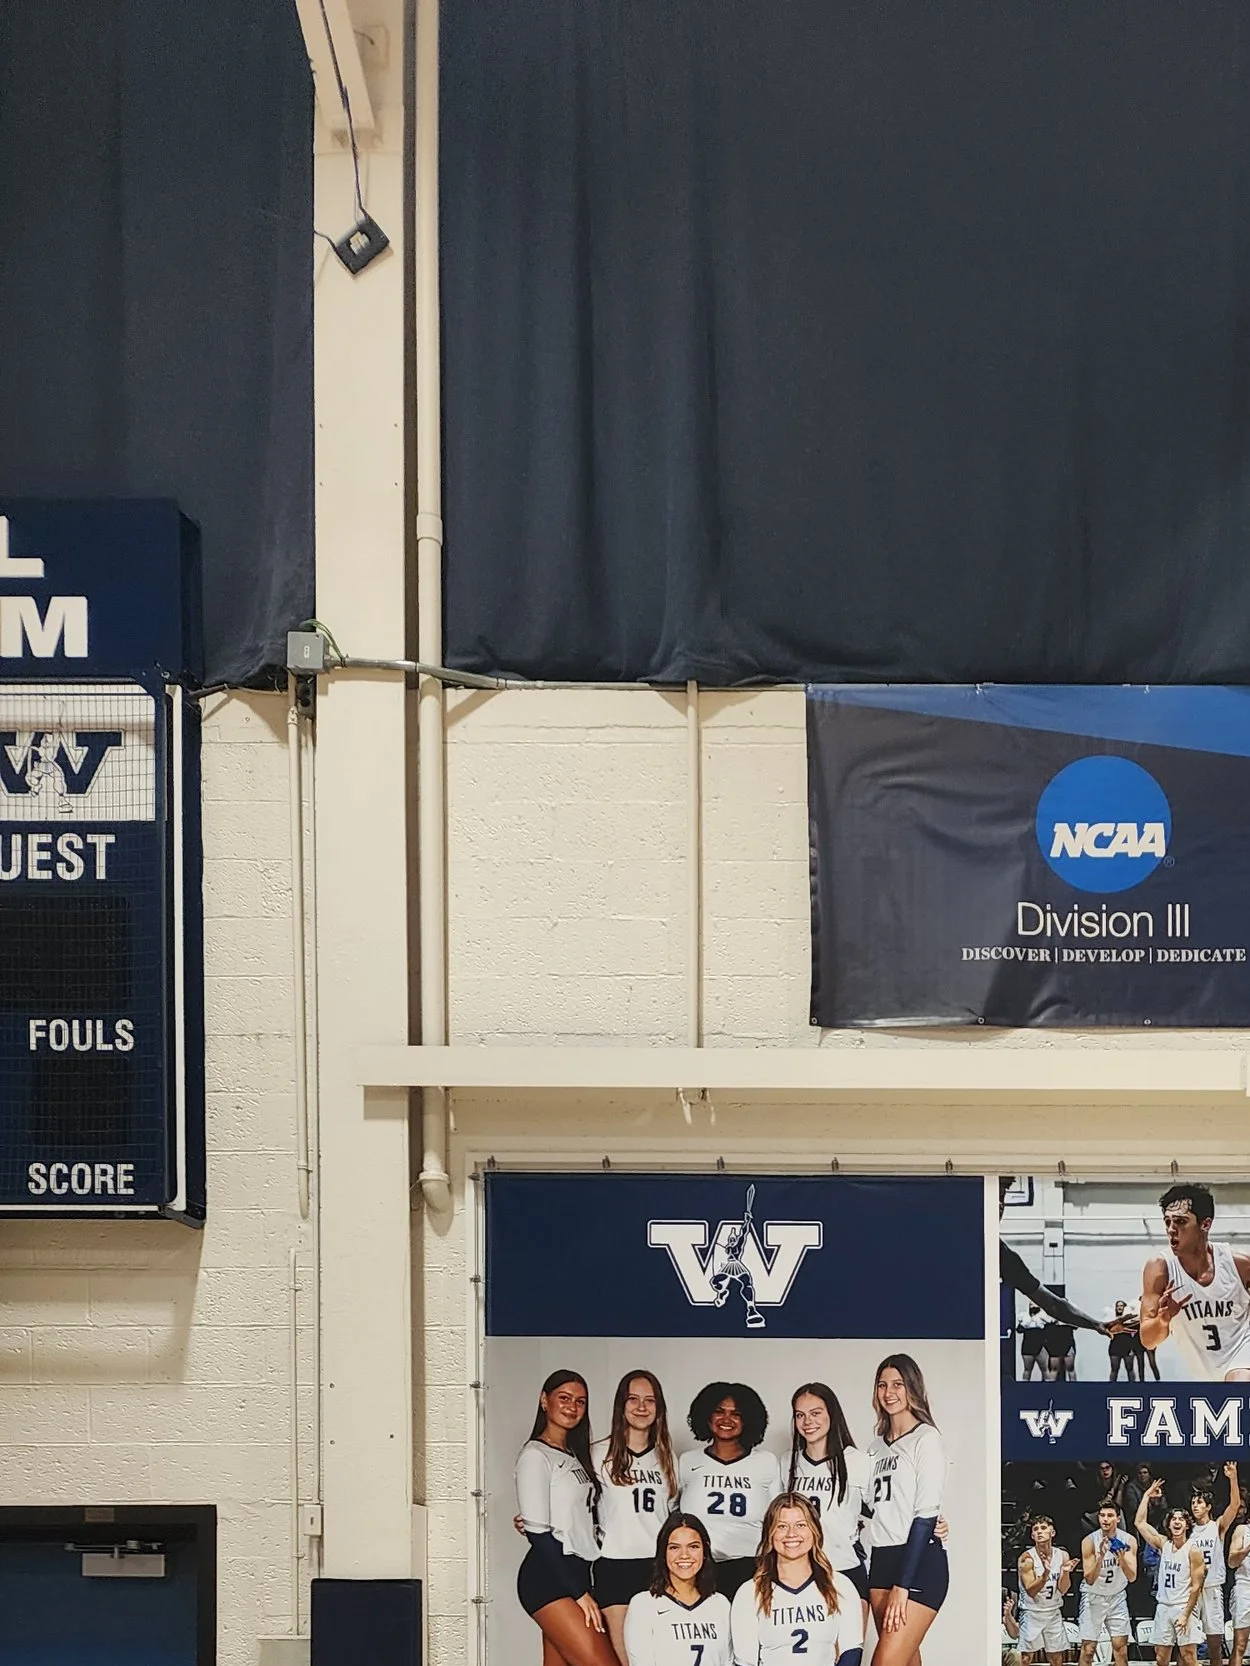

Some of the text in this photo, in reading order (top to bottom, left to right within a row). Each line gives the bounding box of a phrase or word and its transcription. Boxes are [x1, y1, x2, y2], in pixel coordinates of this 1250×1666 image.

[1050, 822, 1166, 858] NCAA
[1017, 902, 1190, 937] Division III
[961, 946, 1246, 962] DISCOVER DEVELOP DEDICATE
[29, 1019, 134, 1051] FOULS
[28, 1163, 134, 1194] SCORE
[647, 1220, 823, 1306] W
[1181, 1300, 1233, 1321] TITANS
[1202, 1324, 1221, 1351] 3
[1020, 1410, 1074, 1437] W
[631, 1469, 662, 1485] TANS
[873, 1456, 899, 1477] TITANS
[703, 1475, 751, 1490] TITANS
[792, 1476, 834, 1491] TITANS
[874, 1475, 892, 1503] 27
[631, 1488, 656, 1513] 16
[707, 1491, 747, 1517] 28
[1105, 1570, 1114, 1584] 2
[1165, 1574, 1176, 1589] 21
[1045, 1585, 1054, 1600] 3
[772, 1604, 825, 1626] TITANS
[671, 1622, 718, 1641] TITANS
[790, 1628, 809, 1654] 2
